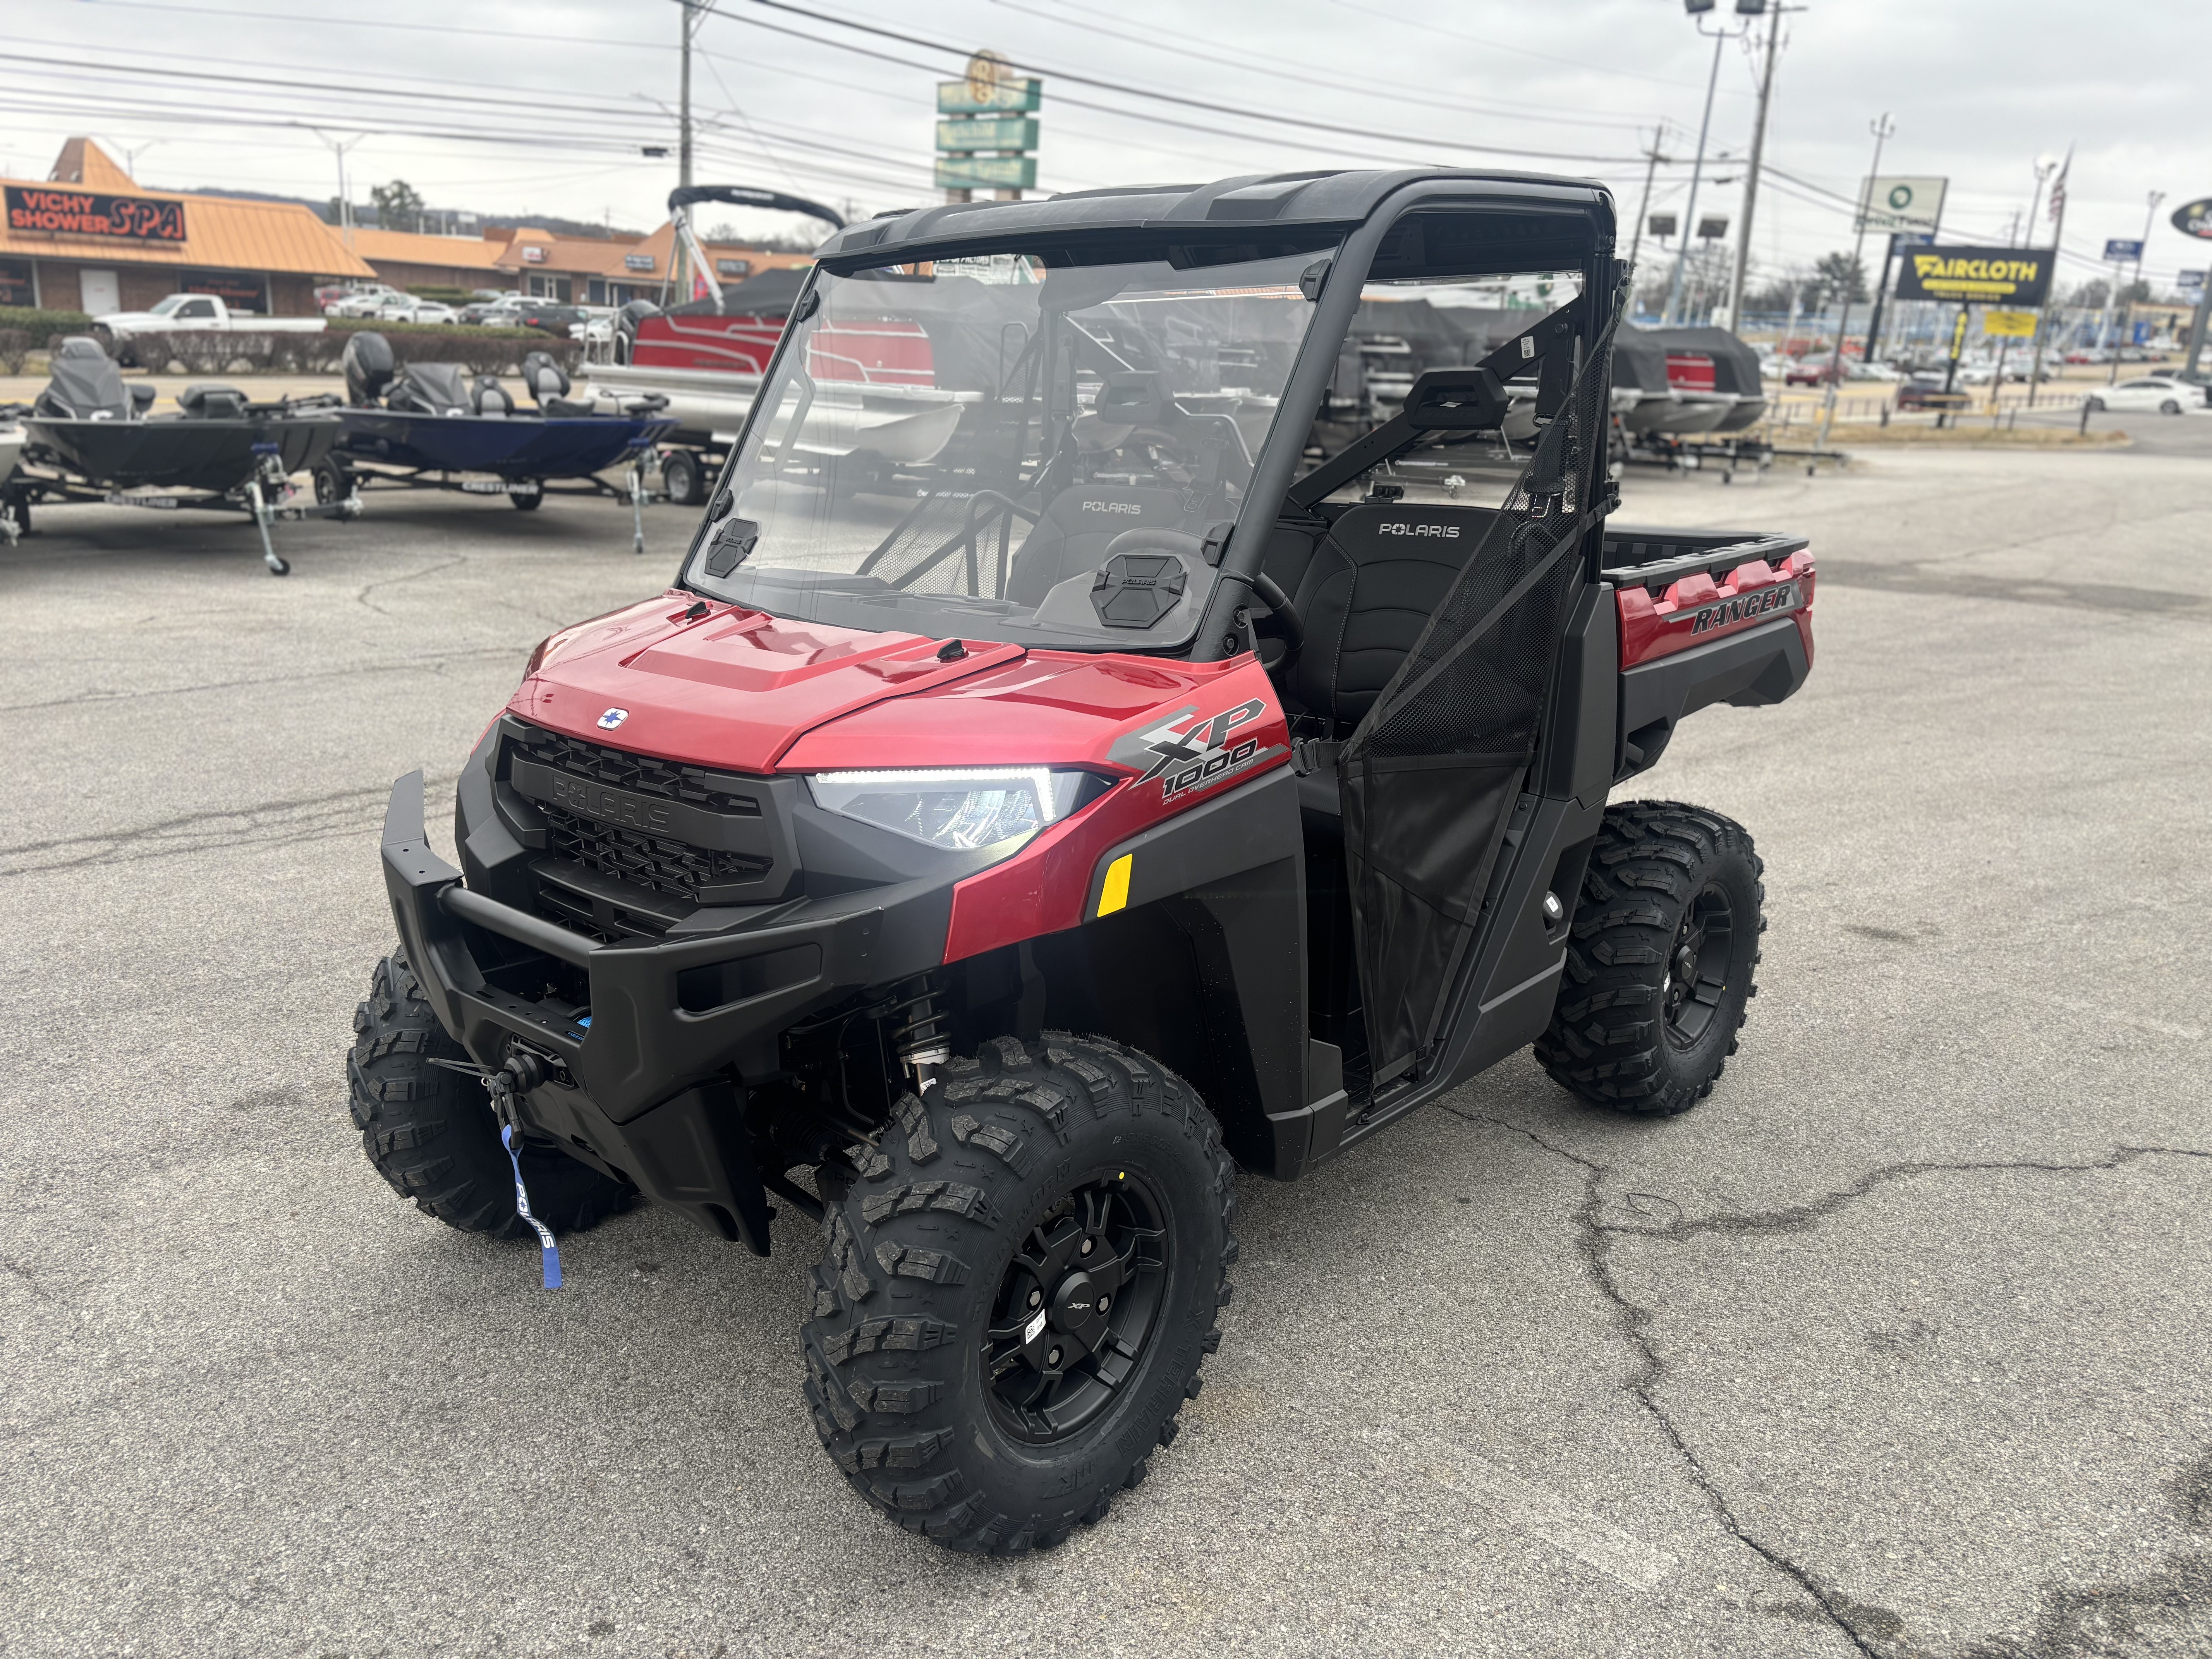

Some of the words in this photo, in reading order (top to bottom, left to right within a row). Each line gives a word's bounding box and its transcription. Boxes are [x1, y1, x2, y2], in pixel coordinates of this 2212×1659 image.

[11, 208, 110, 234] SHOWER
[22, 191, 94, 213] VICHY
[110, 198, 184, 239] SPA
[1913, 254, 2038, 282] FAIRCLOTH
[104, 494, 177, 508] CRESTLINER
[462, 482, 539, 495] CRESTLINER
[1082, 501, 1141, 515] POLARIS
[1379, 524, 1460, 538] POLARIS
[1691, 584, 1791, 636] RANGER
[1127, 697, 1267, 792] XP
[1162, 738, 1258, 799] 1000
[1163, 792, 1186, 806] DUAL
[1188, 769, 1234, 794] OVERHEAD
[1235, 759, 1254, 771] CAM
[553, 775, 671, 832] POLARIS
[516, 1182, 555, 1249] POLARIS
[1116, 1307, 1205, 1456] X-TERRAIN
